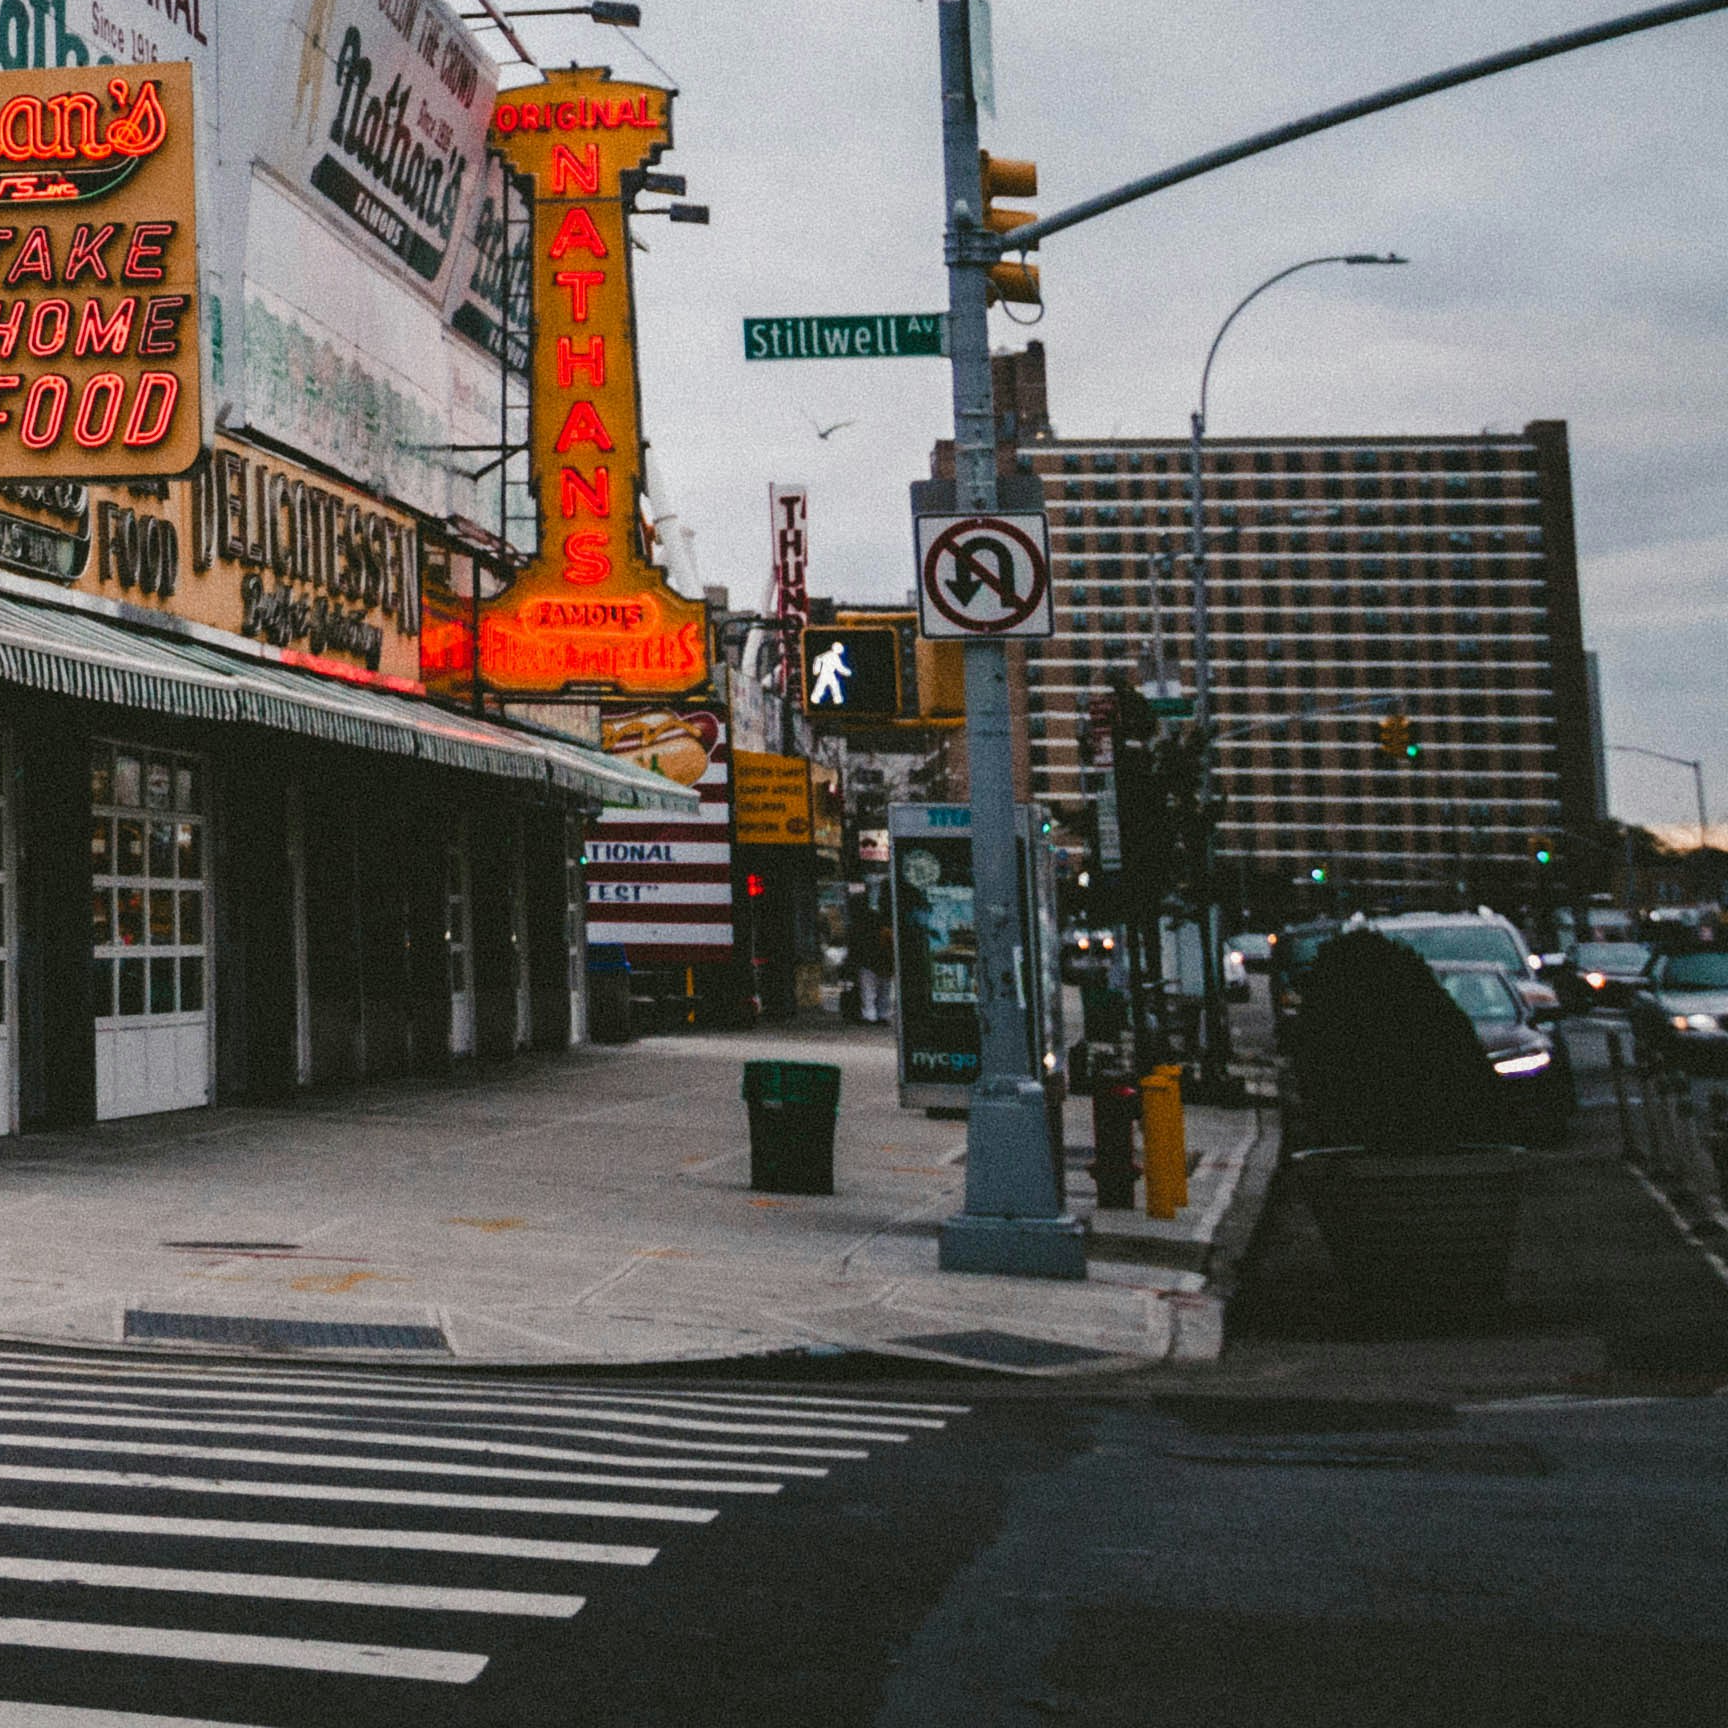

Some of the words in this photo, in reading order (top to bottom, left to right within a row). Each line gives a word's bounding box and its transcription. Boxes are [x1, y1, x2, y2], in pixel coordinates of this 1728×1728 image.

[91, 0, 126, 56] Since
[495, 92, 659, 134] ORIGINAL
[353, 191, 404, 247] FAMOUS
[750, 318, 900, 358] Stillwell
[536, 601, 645, 626] FAMOUS
